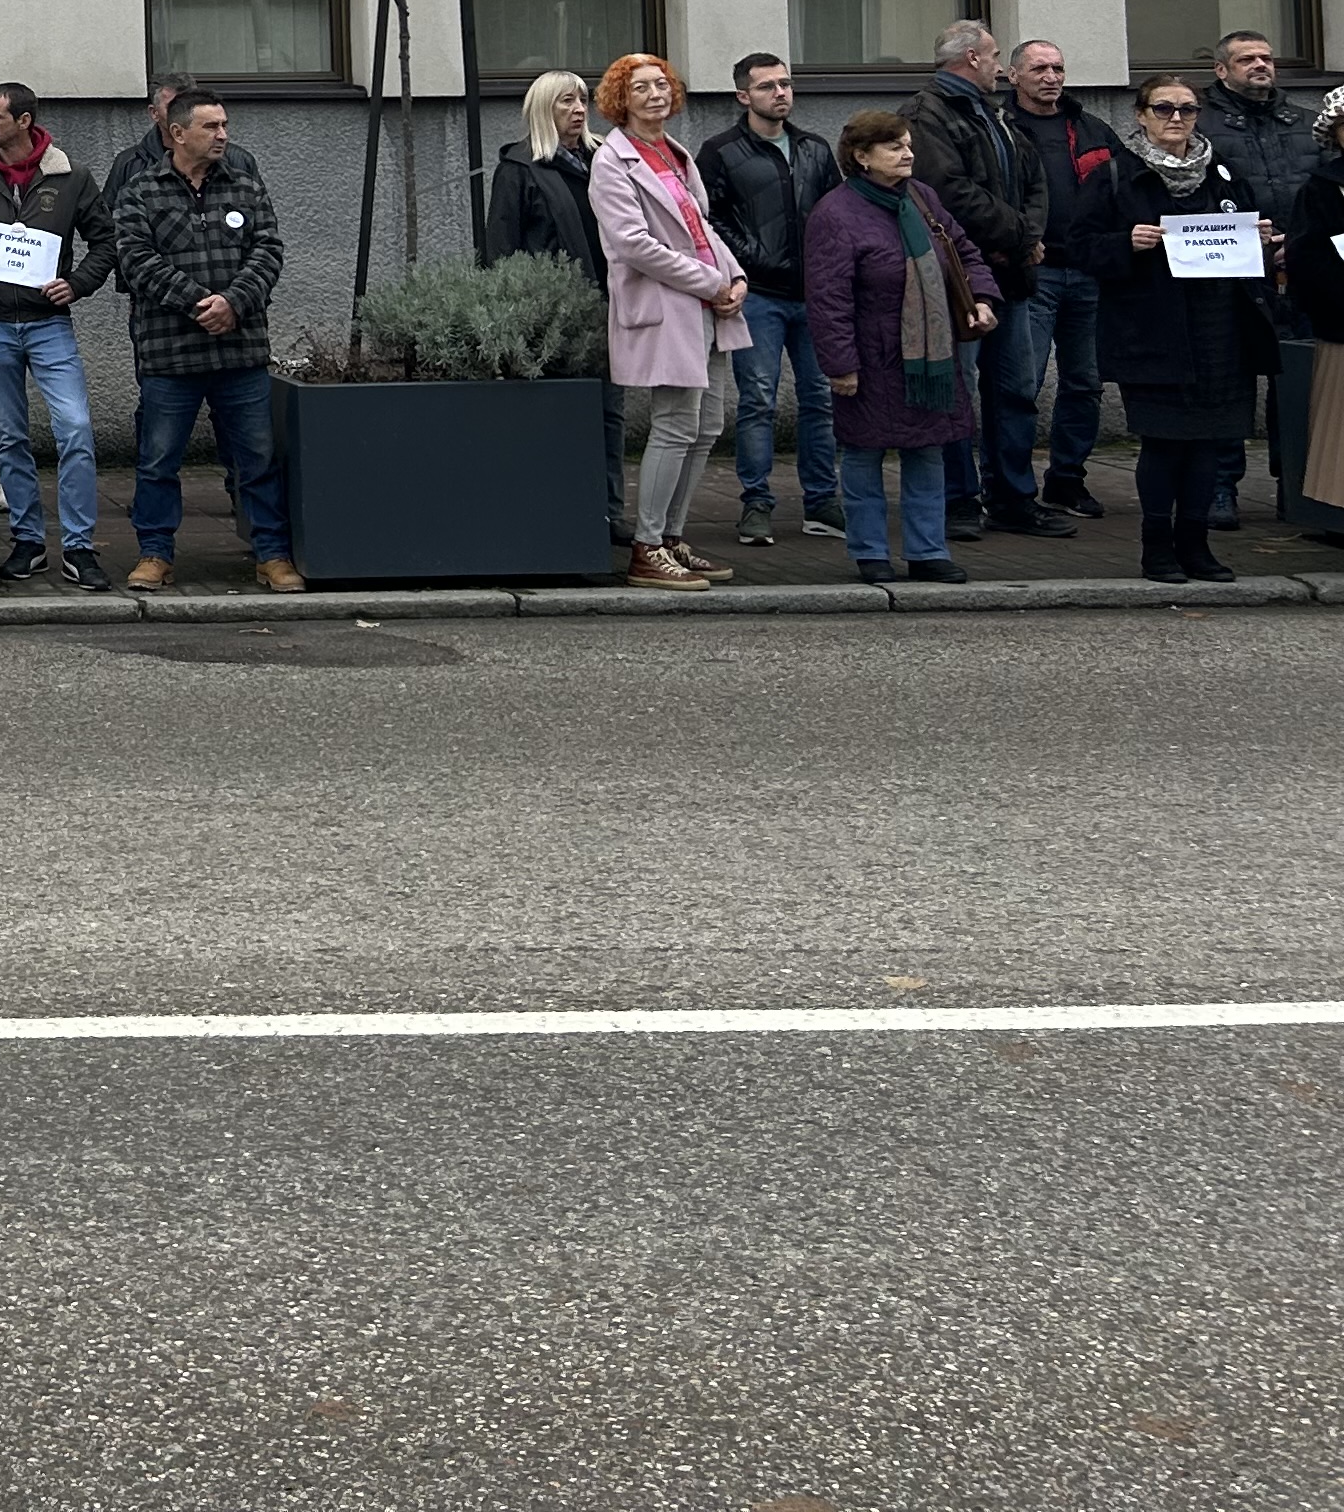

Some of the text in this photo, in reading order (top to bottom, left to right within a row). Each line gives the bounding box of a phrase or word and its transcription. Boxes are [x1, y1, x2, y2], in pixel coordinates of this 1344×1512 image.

[1182, 224, 1236, 233] ВУКАШИН
[1184, 238, 1238, 247] РАКОВИЋ
[5, 246, 31, 257] РАЦА
